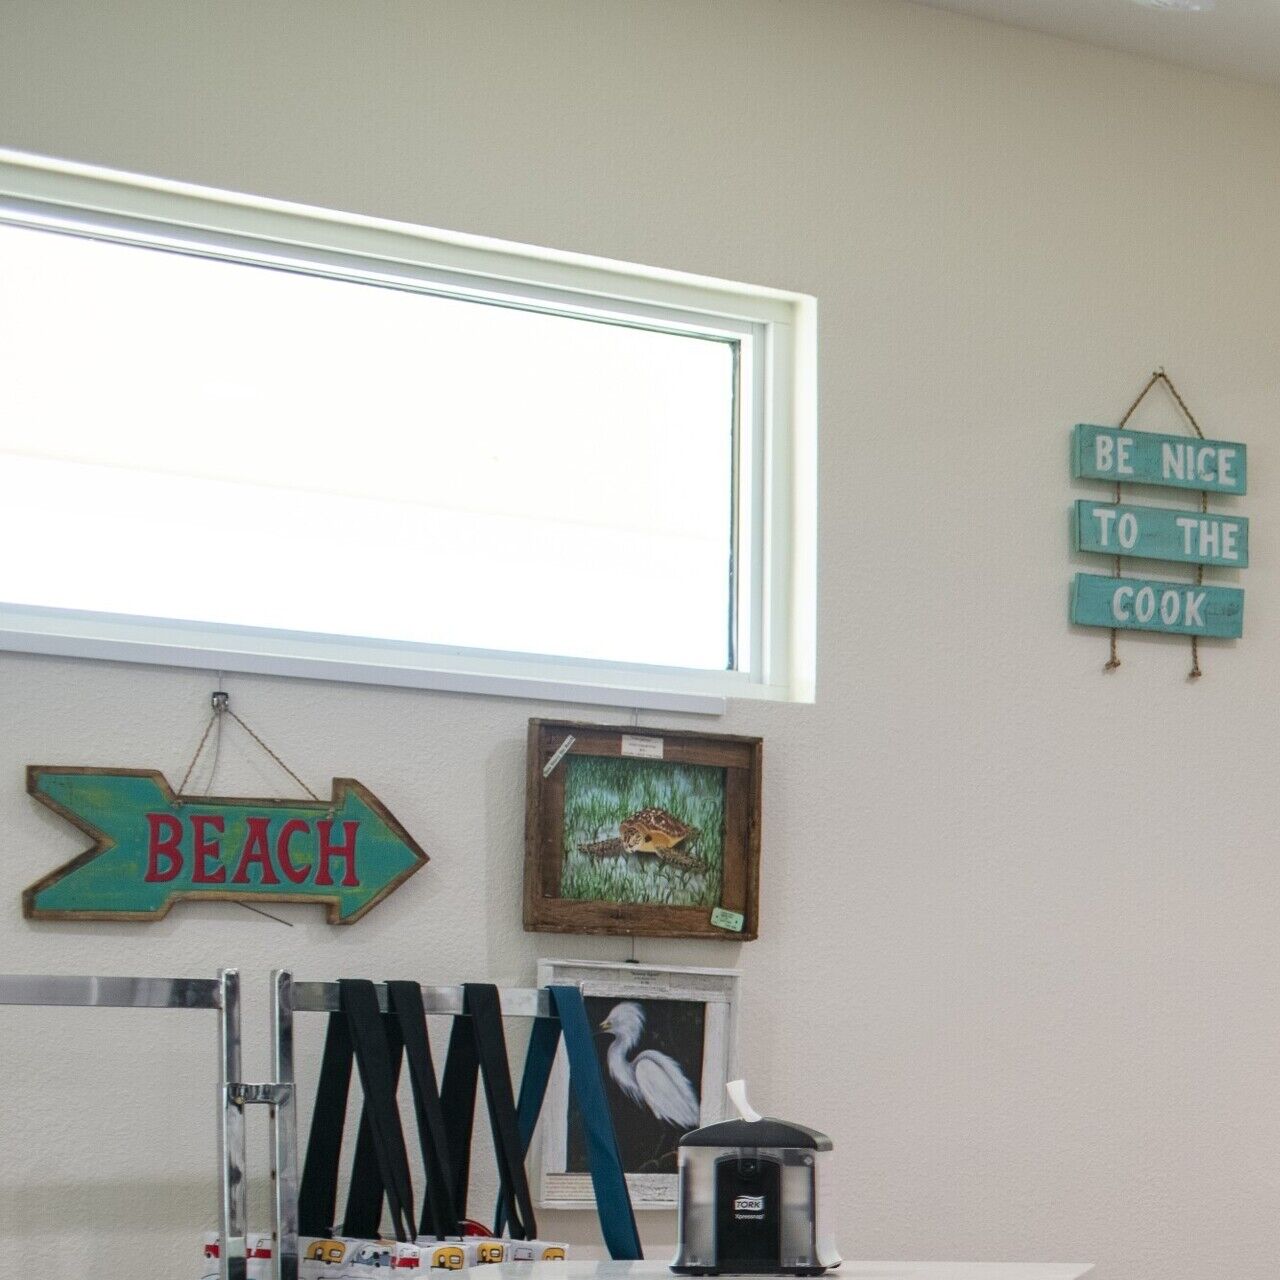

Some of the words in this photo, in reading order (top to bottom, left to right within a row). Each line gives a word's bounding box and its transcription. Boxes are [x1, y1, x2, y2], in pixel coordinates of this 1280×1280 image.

[1095, 434, 1134, 475] BE
[1162, 442, 1237, 487] NICE
[1092, 508, 1138, 550] TO
[1175, 517, 1239, 561] THE
[1112, 585, 1206, 628] COOK
[144, 812, 361, 887] BEACH
